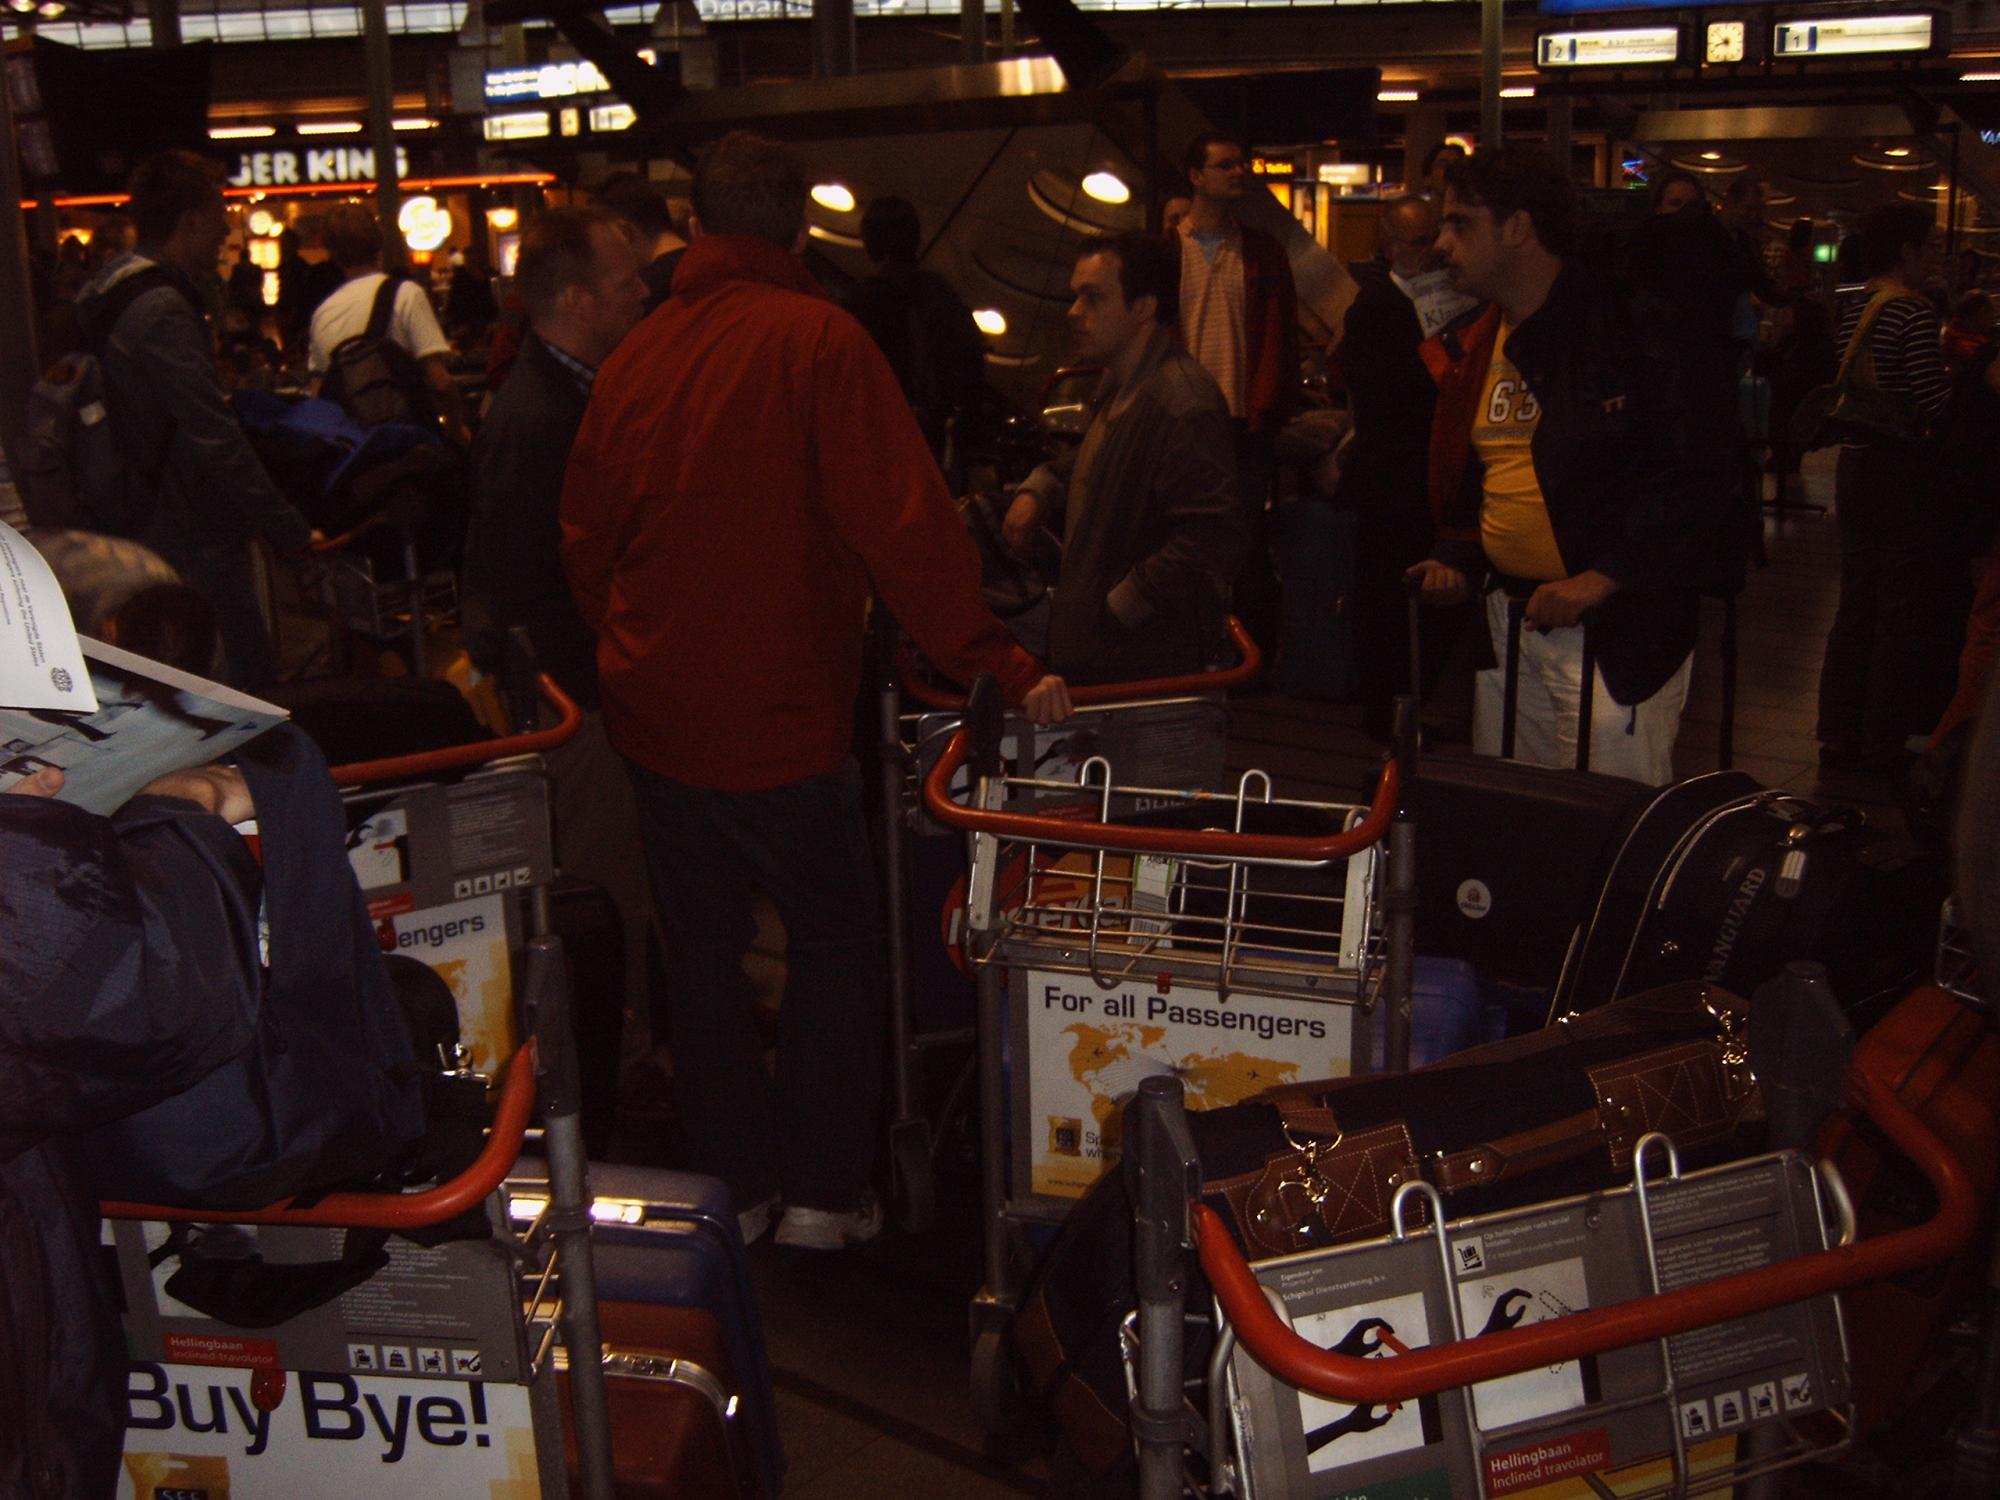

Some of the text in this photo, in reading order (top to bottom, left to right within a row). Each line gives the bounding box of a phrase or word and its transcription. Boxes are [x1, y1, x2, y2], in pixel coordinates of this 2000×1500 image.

[1702, 868, 1766, 982] VANGUARD
[1044, 986, 1326, 1040] For all Passengers
[1283, 1287, 1314, 1301] Schiphol
[170, 1336, 243, 1350] Hellingbaan
[173, 1350, 273, 1363] Inclined travolator
[127, 1362, 491, 1464] Buy Bye!
[1491, 1444, 1572, 1473] Hellingbaan
[1493, 1451, 1604, 1488] Inclined travolator
